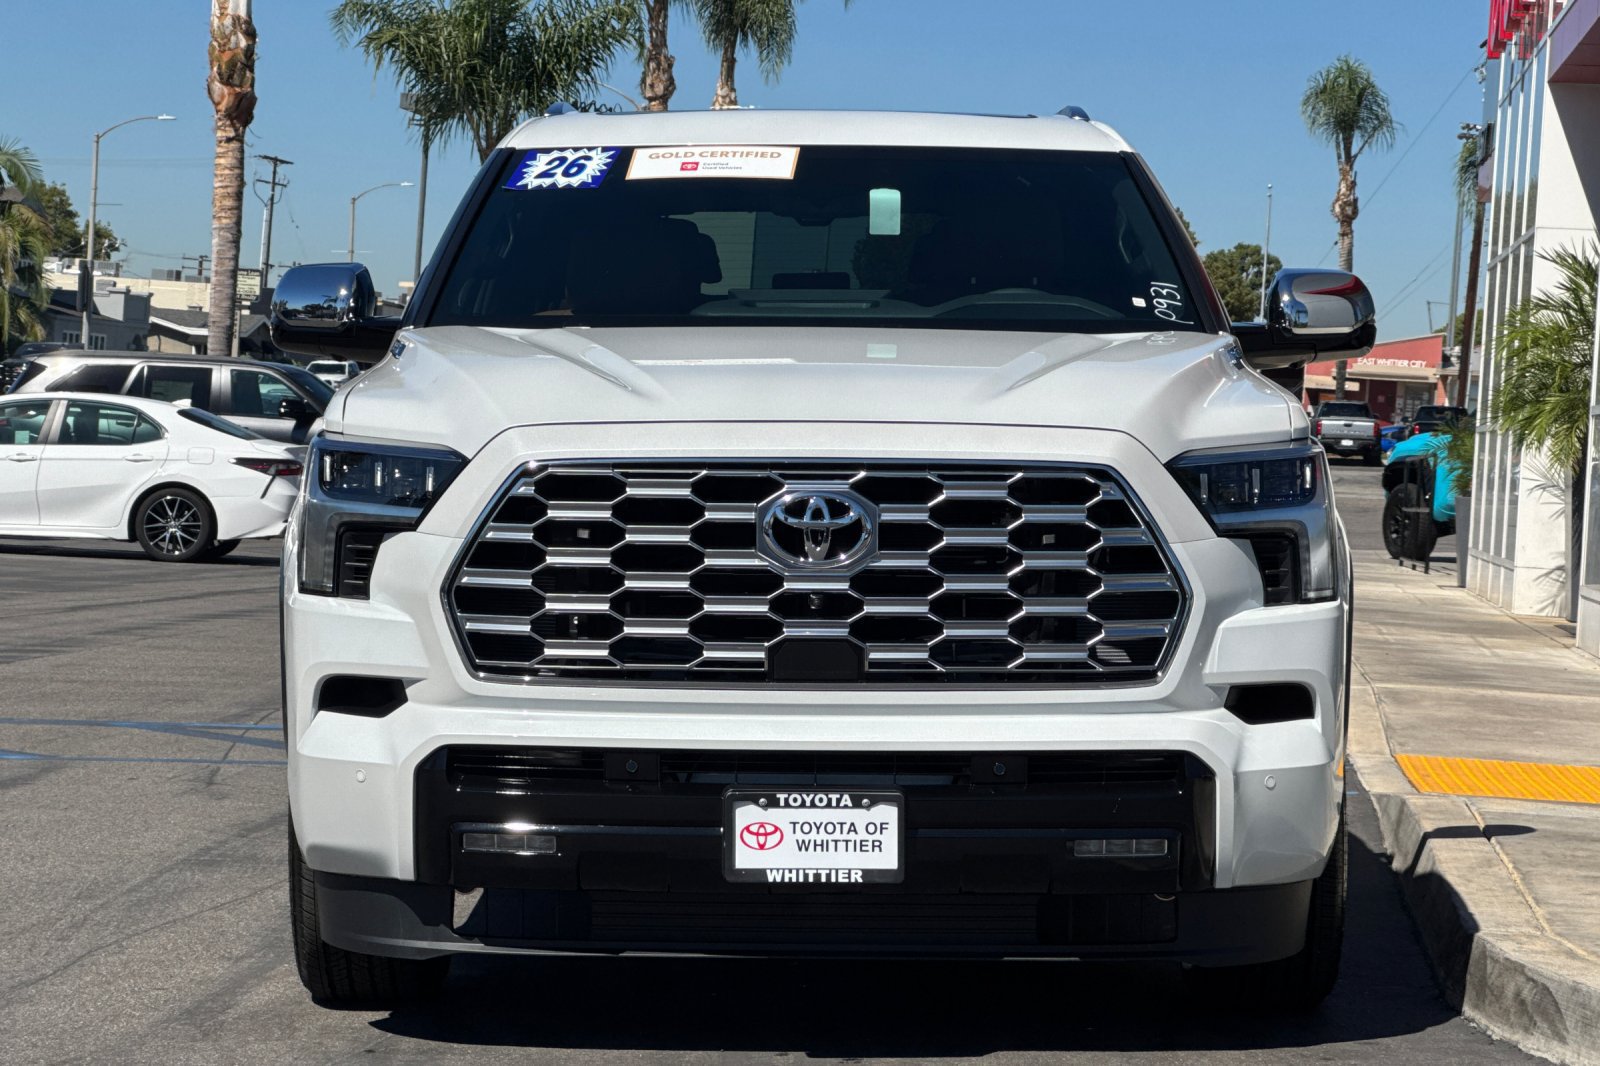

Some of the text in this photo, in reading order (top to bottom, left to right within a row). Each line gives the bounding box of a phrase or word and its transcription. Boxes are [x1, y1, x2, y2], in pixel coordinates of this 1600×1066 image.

[648, 150, 782, 159] GOLD CERTIFIED
[533, 154, 594, 179] 26
[1357, 357, 1427, 368] EAST WHITTIER CITY
[776, 793, 853, 807] TOYOTA
[789, 821, 889, 835] TOYOTA OF
[796, 839, 883, 852] WHITTIER
[766, 869, 863, 882] WHITTIER
